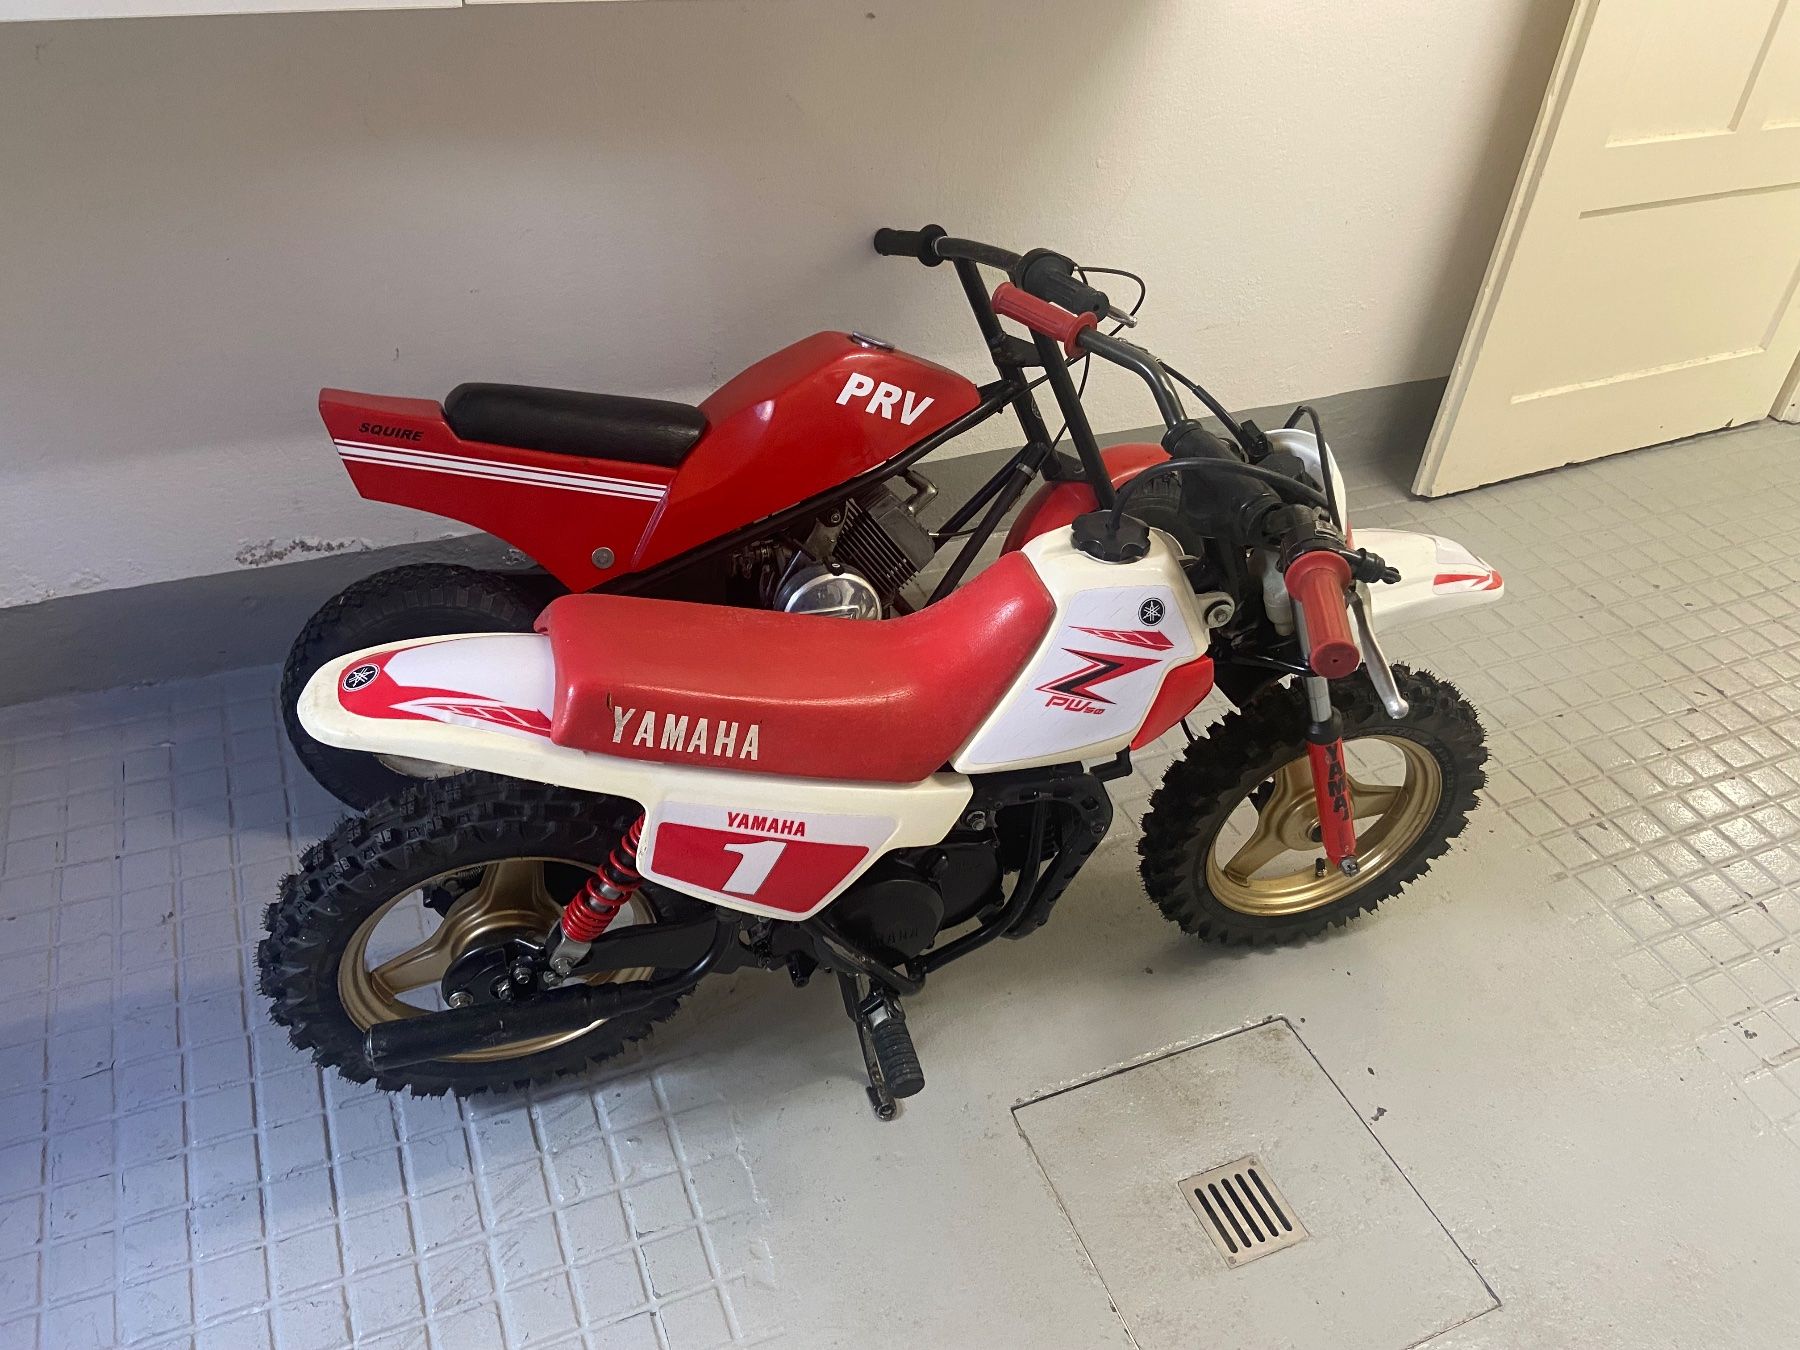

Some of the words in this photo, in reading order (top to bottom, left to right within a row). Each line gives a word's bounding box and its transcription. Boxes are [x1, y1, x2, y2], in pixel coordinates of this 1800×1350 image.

[835, 372, 935, 426] PRV
[359, 422, 424, 441] SQUIRE
[612, 705, 760, 761] YAMAHA
[727, 811, 806, 837] YAMAHA
[723, 840, 788, 895] 1
